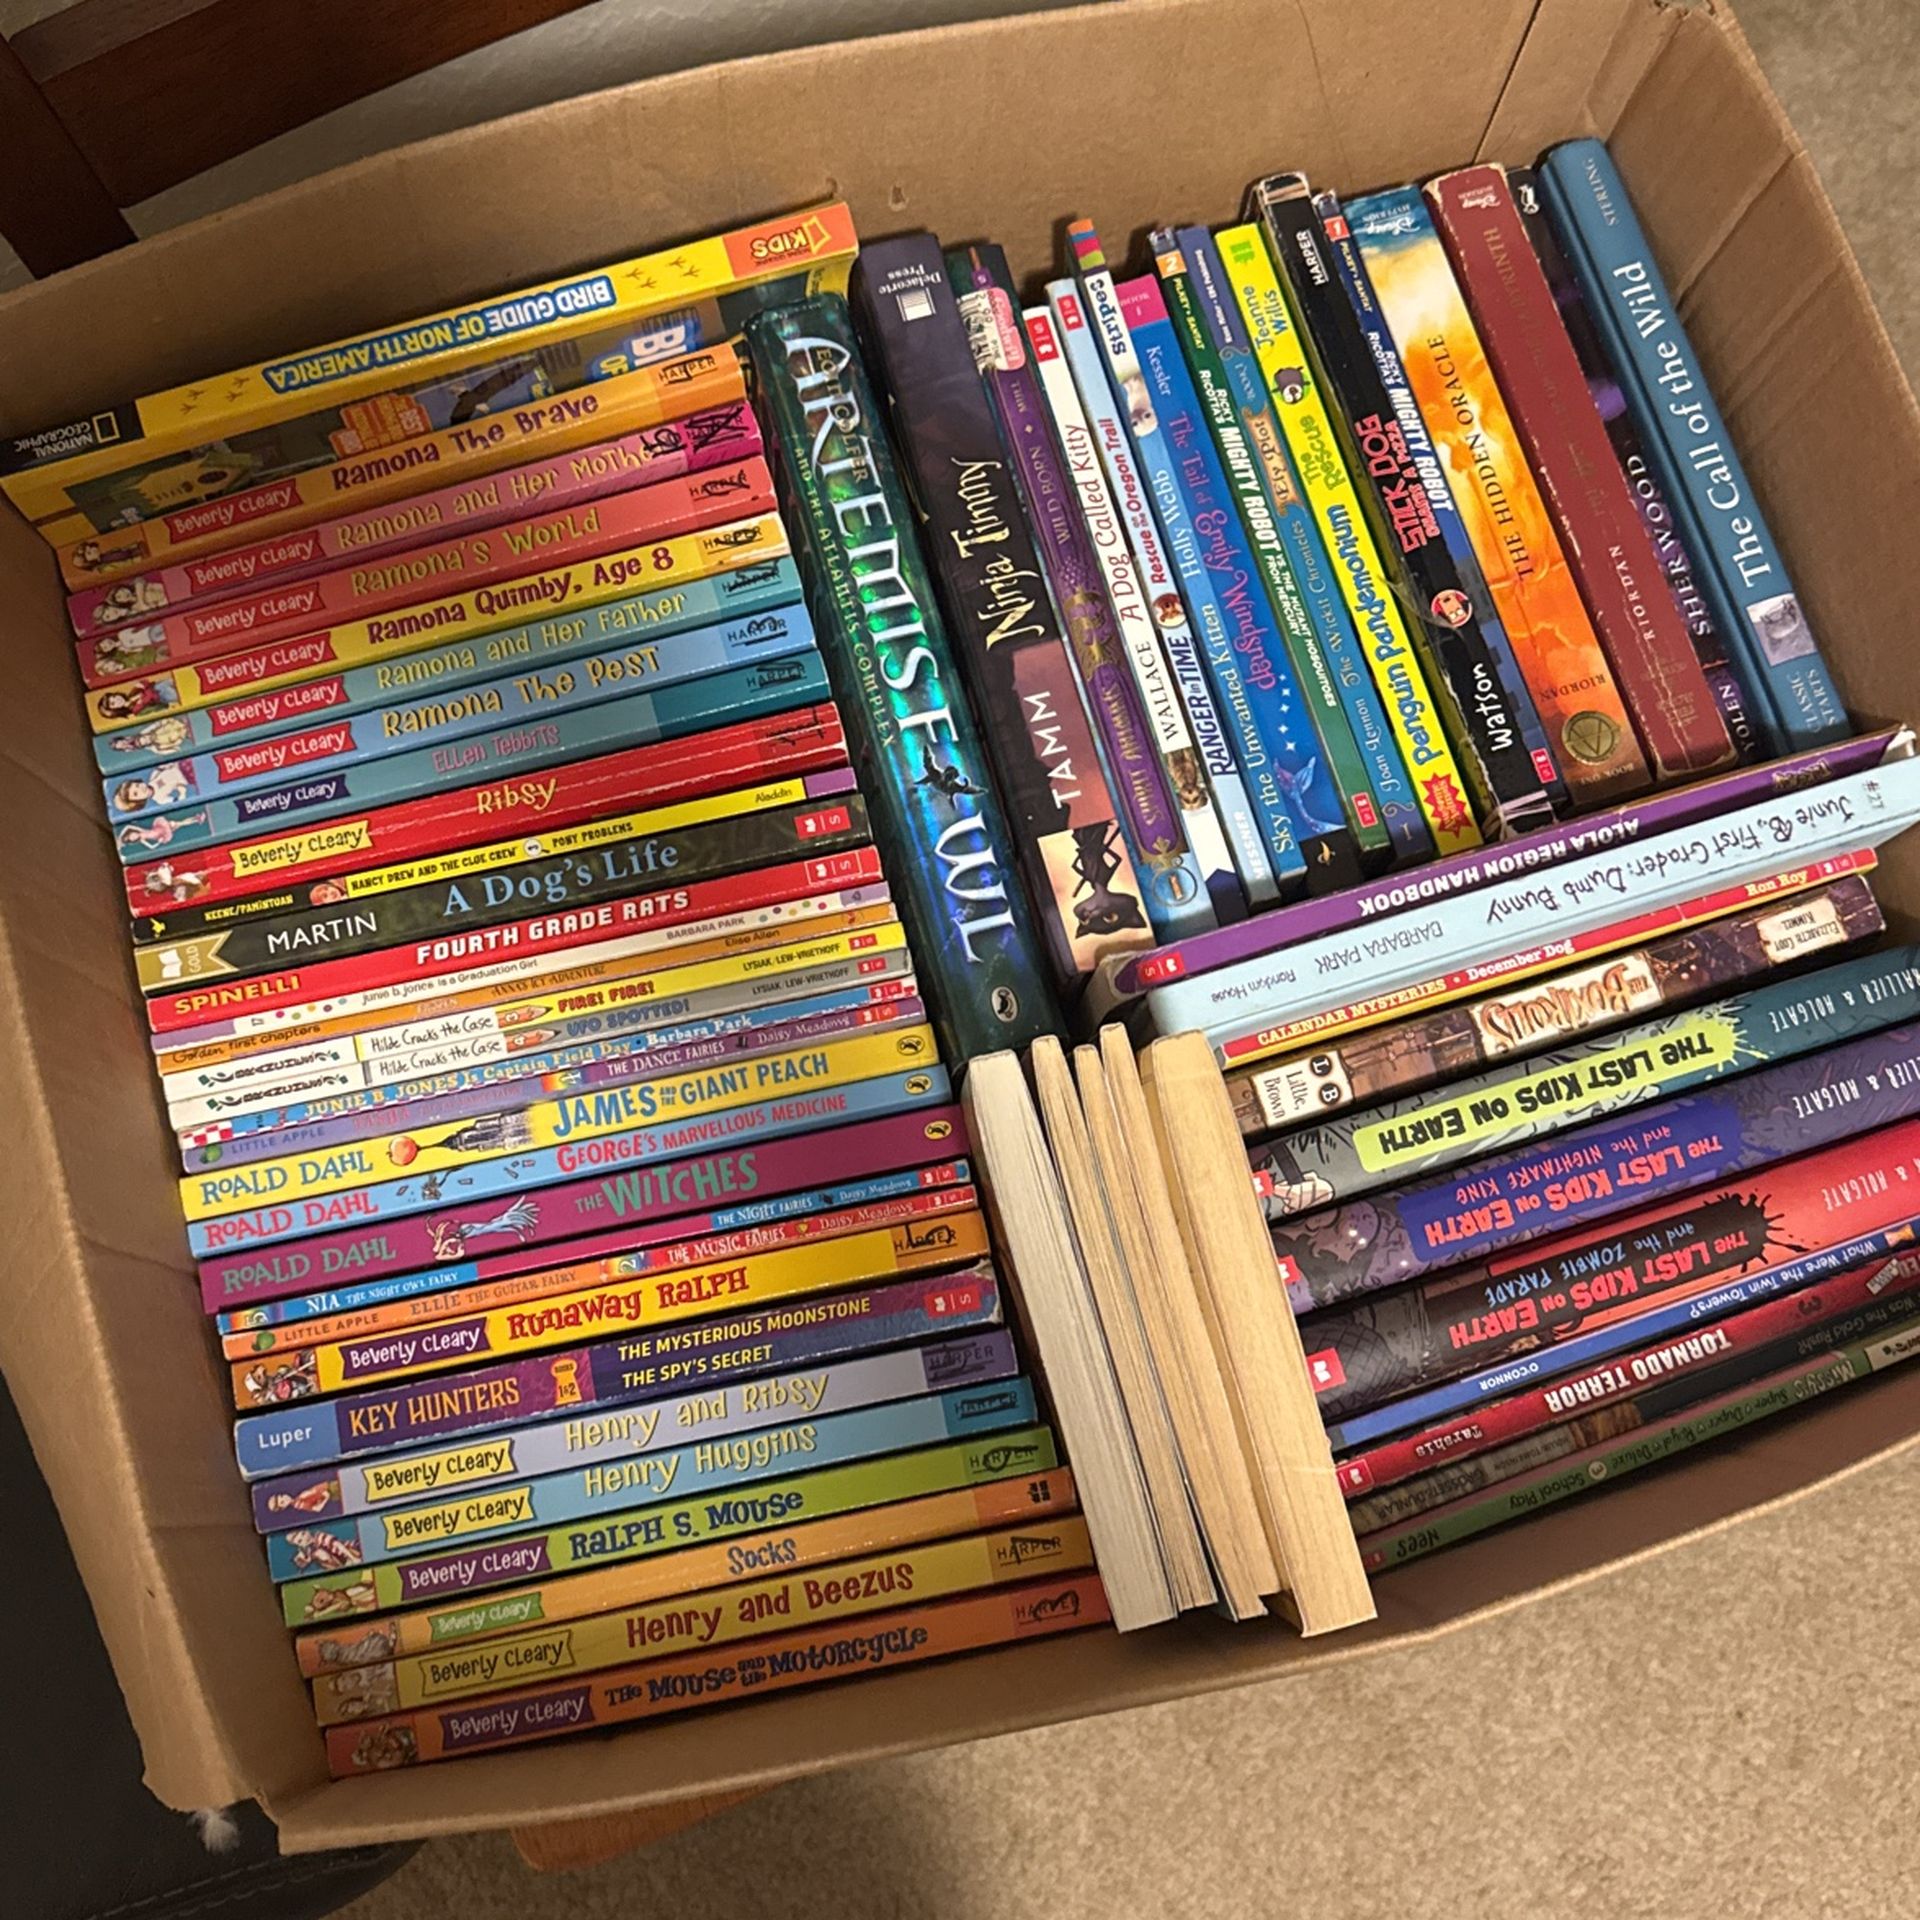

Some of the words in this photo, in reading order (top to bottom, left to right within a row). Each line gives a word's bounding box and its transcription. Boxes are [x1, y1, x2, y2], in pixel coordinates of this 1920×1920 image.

[750, 225, 808, 259] KIDS
[1296, 229, 1324, 286] HARPER
[559, 278, 611, 314] BIRD
[879, 271, 942, 295] Delacorte
[887, 264, 925, 280] Press
[490, 293, 555, 331] GUIDE
[1243, 286, 1274, 350] Jeanne
[1264, 289, 1288, 337] Willis
[1612, 261, 1667, 339] Wild
[378, 321, 451, 364] NORTH
[457, 317, 484, 341] OF
[268, 350, 378, 388] AMERICA
[1146, 345, 1171, 397] Kessler
[1428, 334, 1475, 427] ORACLE
[1657, 341, 1693, 395] the
[14, 421, 92, 451] GEOGRAPHIC
[1098, 418, 1121, 452] Trail
[1669, 401, 1710, 434] of
[35, 433, 93, 458] NATIONAL
[332, 442, 440, 490] Ramona
[450, 424, 505, 454] The
[515, 394, 599, 426] Brave
[1065, 424, 1095, 472] Kitty
[1355, 413, 1400, 477] DOG
[1390, 388, 1425, 452] MIGHTY
[1415, 456, 1453, 512] ROBOT
[1116, 454, 1142, 512] Oregon
[1152, 469, 1180, 526] Webb
[1218, 427, 1258, 497] MIGHTY
[1243, 497, 1281, 552] ROBOT
[1465, 433, 1514, 525] HIDDEN
[1688, 442, 1740, 511] Call
[337, 504, 442, 549] Ramona
[454, 483, 500, 516] and
[510, 467, 560, 492] Her
[785, 336, 939, 690] ARTEMIS
[1082, 477, 1117, 547] Called
[351, 540, 490, 597] Ramona's
[1140, 530, 1167, 584] Rescue
[1174, 527, 1200, 579] Holly
[1505, 531, 1534, 583] THE
[1626, 454, 1713, 637] SHERWOOD
[1733, 516, 1771, 588] The
[367, 601, 467, 644] Ramona
[475, 573, 582, 615] Quimby,
[593, 556, 642, 586] Age
[652, 547, 674, 571] 8
[1109, 553, 1134, 598] Dog
[1326, 503, 1406, 662] Pandemonium
[1119, 604, 1143, 621] A
[377, 646, 476, 690] Ramona
[487, 629, 530, 661] and
[541, 618, 587, 647] Her
[1168, 636, 1200, 686] TIME
[383, 688, 502, 739] Ramona
[513, 670, 576, 704] The
[1136, 641, 1178, 740] WALLACE
[1386, 662, 1443, 766] Penguin
[1473, 663, 1514, 752] Watson
[1024, 691, 1082, 810] TAMM
[1190, 693, 1238, 776] RANGER
[476, 778, 557, 814] Ribsy
[351, 874, 385, 890] NANCY
[387, 867, 414, 883] DREW
[418, 862, 438, 879] AND
[441, 857, 461, 873] THE
[462, 852, 488, 868] CLUE
[489, 846, 516, 863] CREW
[552, 832, 579, 848] PONY
[581, 822, 634, 842] PROBLEMS
[1270, 814, 1294, 854] Sky
[1573, 817, 1640, 850] ALOLA
[1485, 839, 1568, 880] REGION
[267, 912, 377, 954] MARTIN
[443, 885, 473, 916] A
[480, 857, 594, 908] Dog's
[600, 839, 679, 881] Life
[1357, 864, 1480, 917] HANDBOOK
[175, 975, 300, 1015] SPINELLI
[417, 926, 518, 966] FOURTH
[528, 906, 613, 942] GRADE
[622, 892, 690, 919] RATS
[1314, 949, 1363, 975] PARK
[1367, 920, 1444, 958] BARBARA
[1257, 1009, 1346, 1047] CALENDAR
[1349, 979, 1448, 1020] MYSTERIES
[1466, 950, 1542, 981] December
[1543, 938, 1576, 960] Dog
[1769, 993, 1836, 1033] HOLGATE
[462, 1014, 493, 1035] Case
[469, 1036, 501, 1056] Case
[304, 1091, 369, 1116] JUNIE
[395, 1073, 458, 1098] JONES
[1514, 1068, 1584, 1113] KIDS
[1587, 1049, 1655, 1092] LAST
[1469, 1099, 1510, 1126] ON
[1793, 1079, 1860, 1119] HOLGATE
[200, 1165, 288, 1206] ROALD
[299, 1150, 374, 1185] DAHL
[552, 1086, 657, 1137] JAMES
[681, 1067, 748, 1107] GIANT
[756, 1051, 830, 1087] PEACH
[231, 1136, 275, 1154] LITTLE
[281, 1127, 325, 1145] APPLE
[1379, 1108, 1468, 1155] EARTH
[204, 1207, 293, 1248] ROALD
[304, 1192, 379, 1227] DAHL
[663, 1110, 766, 1147] MARVELLOUS
[771, 1093, 848, 1123] MEDICINE
[1543, 1167, 1613, 1210] KIDS
[1617, 1146, 1685, 1186] LAST
[1456, 1178, 1500, 1205] KING
[1516, 1193, 1541, 1213] ON
[1821, 1169, 1889, 1212] HOLGATE
[222, 1255, 311, 1295] ROALD
[321, 1236, 397, 1272] DAHL
[602, 1152, 759, 1217] WITCHES
[1424, 1203, 1514, 1249] EARTH
[1561, 1243, 1626, 1281] ZOMBIE
[1643, 1242, 1711, 1282] LAST
[1806, 1251, 1840, 1273] Were
[1842, 1241, 1878, 1259] What
[306, 1292, 340, 1313] NIA
[1484, 1268, 1552, 1308] PARADE
[1570, 1269, 1638, 1311] KIDS
[1690, 1287, 1748, 1319] Towers?
[1749, 1276, 1779, 1295] Twin
[284, 1323, 331, 1342] LITTLE
[336, 1313, 379, 1333] APPLE
[409, 1294, 462, 1316] ELLIE
[1450, 1302, 1539, 1350] EARTH
[259, 1425, 312, 1452] Luper
[350, 1402, 398, 1437] KEY
[408, 1378, 520, 1425] HUNTERS
[618, 1340, 651, 1361] THE
[656, 1320, 762, 1354] MYSTERIOUS
[767, 1297, 871, 1331] MOONSTONE
[622, 1367, 655, 1388] THE
[660, 1357, 707, 1380] SPY'S
[711, 1345, 773, 1371] SECRET
[1631, 1328, 1732, 1381] TORNADO
[565, 1408, 660, 1450] Henry
[677, 1391, 727, 1427] and
[744, 1374, 829, 1412] Ribsy
[1545, 1370, 1631, 1413] TERROR
[584, 1454, 680, 1497] Henry
[695, 1423, 817, 1473] Huggins
[626, 1607, 723, 1648] Henry
[738, 1586, 790, 1623] and
[803, 1562, 914, 1609] Beezus
